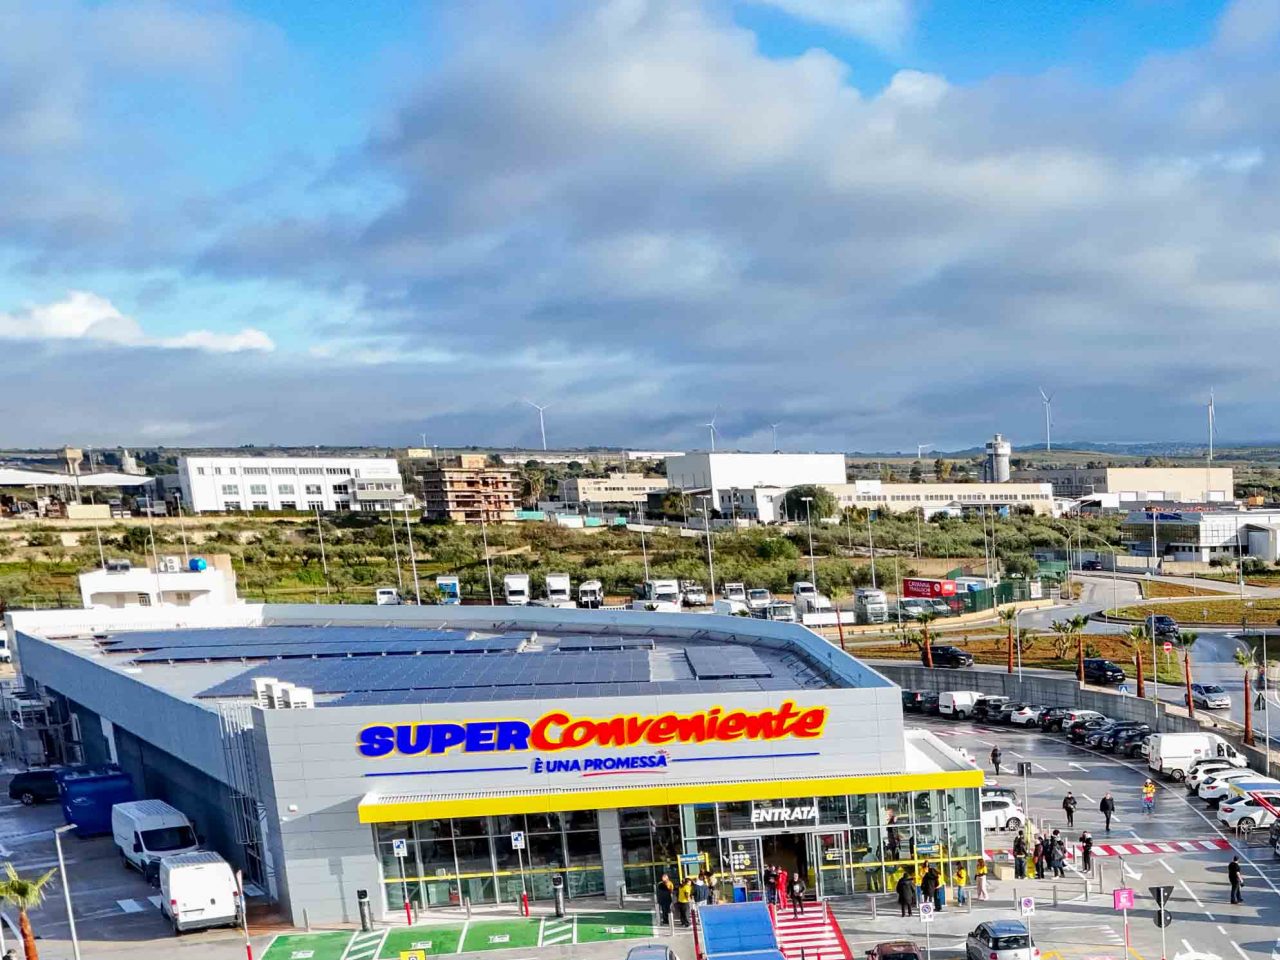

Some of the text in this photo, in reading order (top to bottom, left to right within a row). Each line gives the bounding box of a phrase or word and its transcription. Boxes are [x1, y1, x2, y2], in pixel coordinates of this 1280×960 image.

[546, 760, 581, 773] UNA
[584, 755, 667, 771] PROMESSA
[751, 806, 819, 822] ENTRATA
